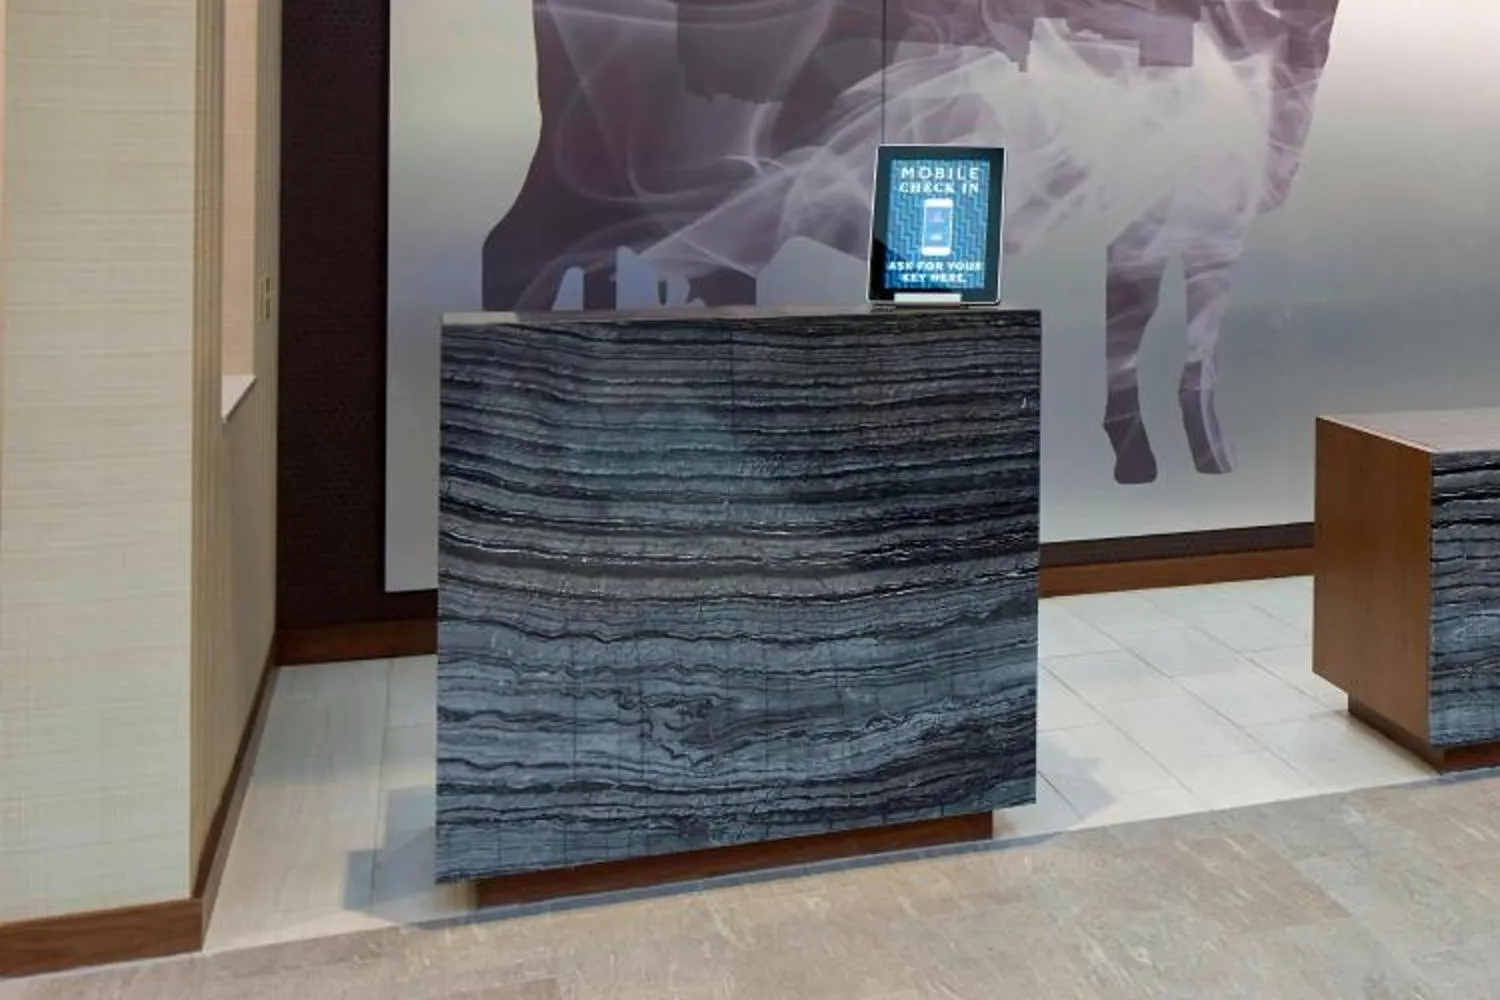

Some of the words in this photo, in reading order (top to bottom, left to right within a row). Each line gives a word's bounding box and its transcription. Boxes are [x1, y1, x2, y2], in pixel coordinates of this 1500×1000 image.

[901, 167, 979, 180] MOBILE
[899, 182, 955, 193] CHECK
[962, 183, 979, 193] IN
[887, 261, 913, 271] ASK
[917, 261, 943, 271] FOR
[947, 261, 982, 271] YOUR
[902, 274, 926, 282] KEY
